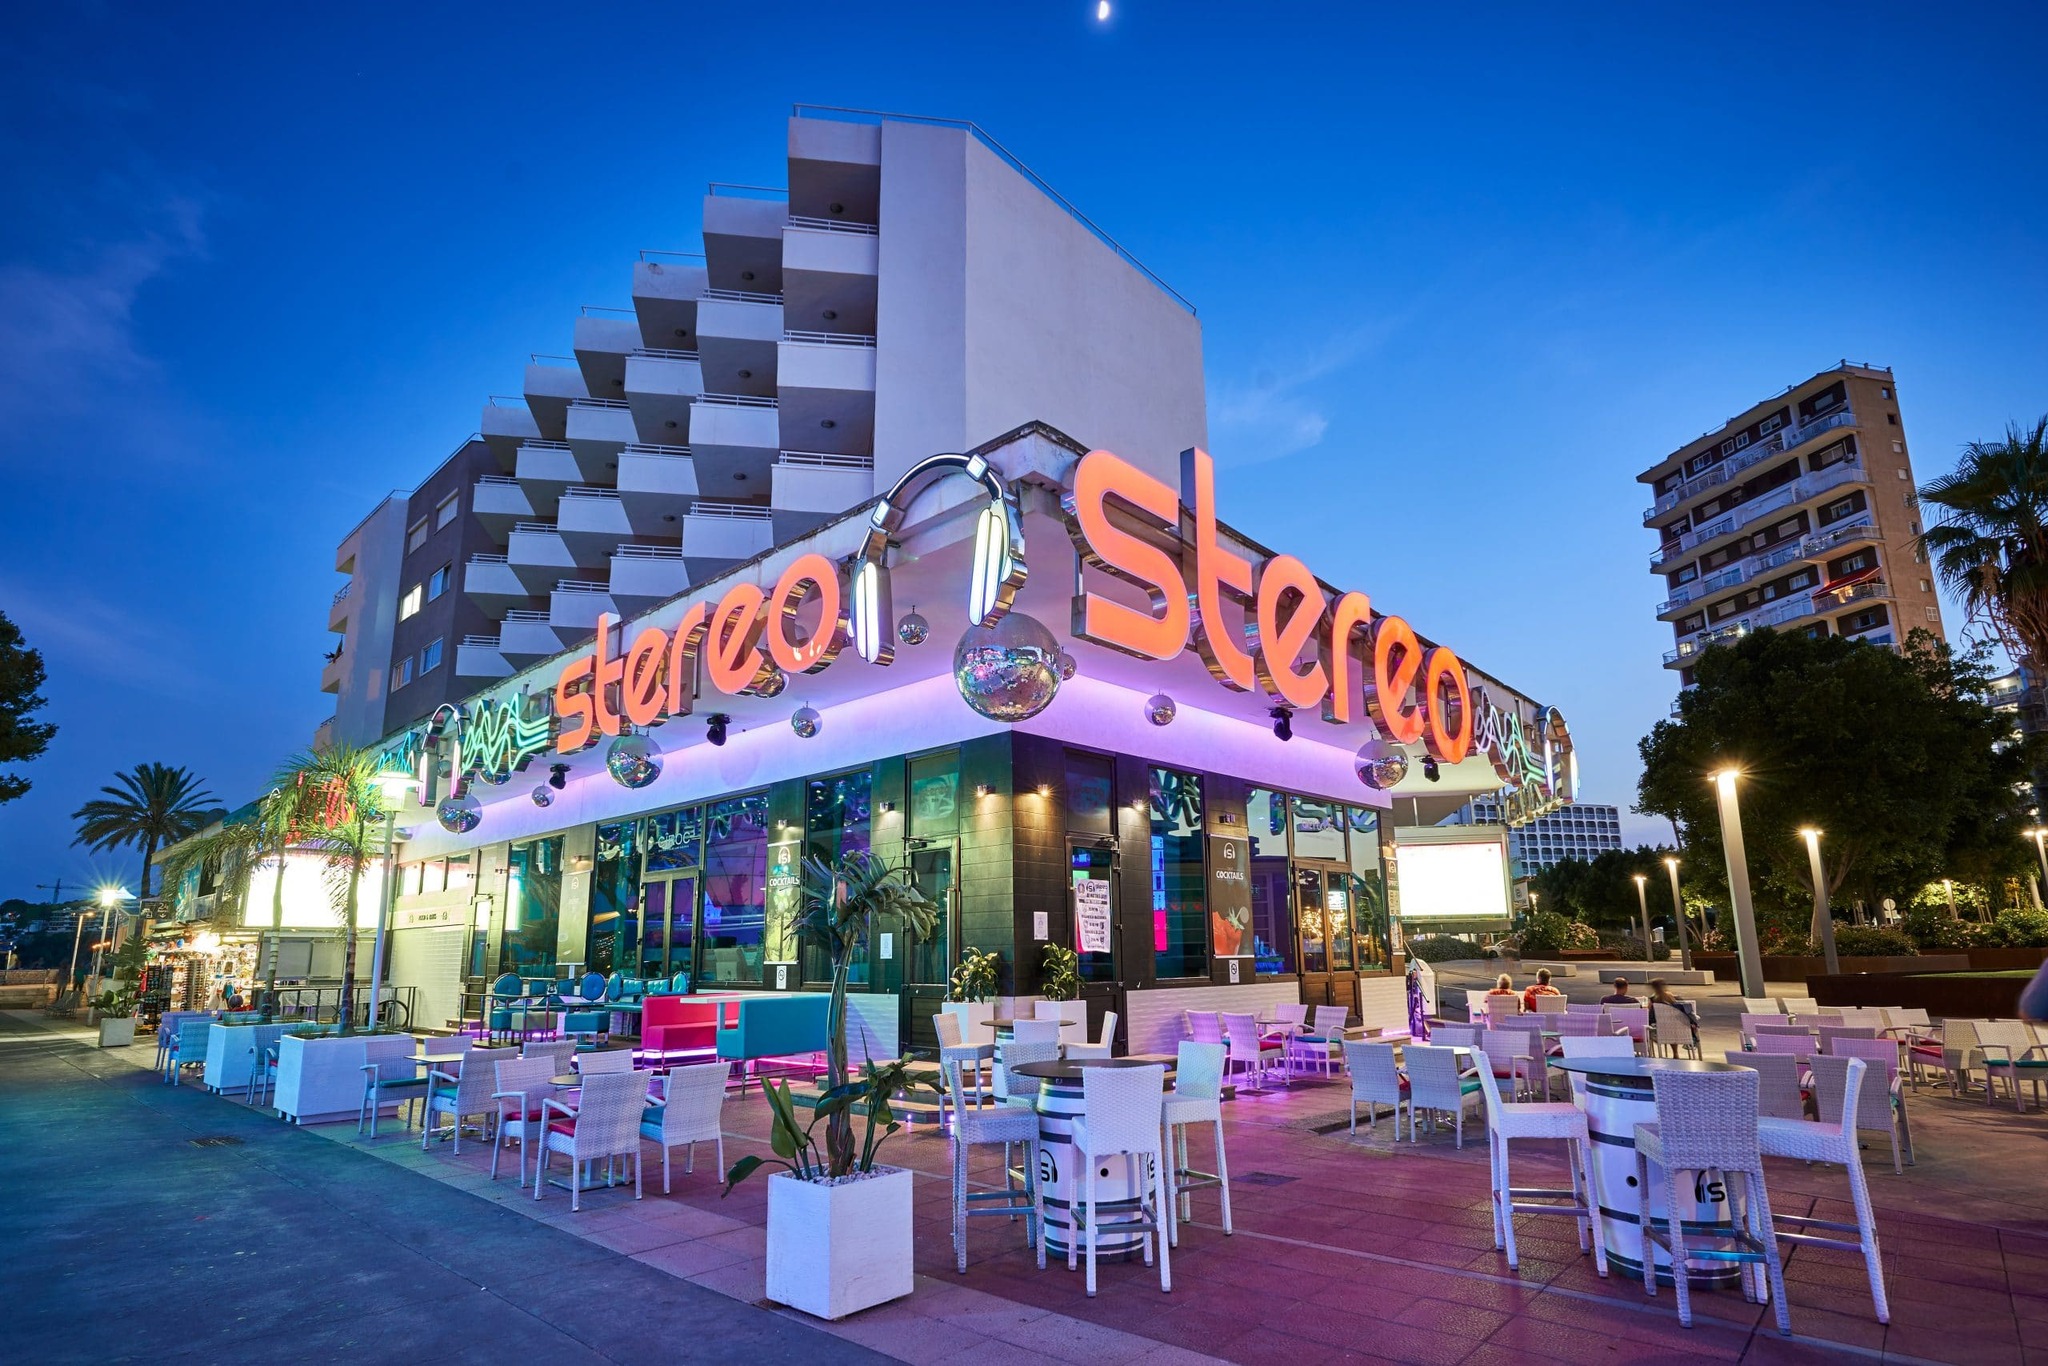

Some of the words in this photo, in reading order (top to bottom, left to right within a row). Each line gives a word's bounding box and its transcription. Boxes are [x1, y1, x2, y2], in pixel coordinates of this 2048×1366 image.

[1074, 446, 1473, 765] stereo
[556, 553, 841, 753] stereo
[769, 876, 799, 887] COCKTAILS
[1216, 870, 1243, 880] COCKTAILS
[1041, 1163, 1050, 1182] S
[1707, 1182, 1726, 1202] S
